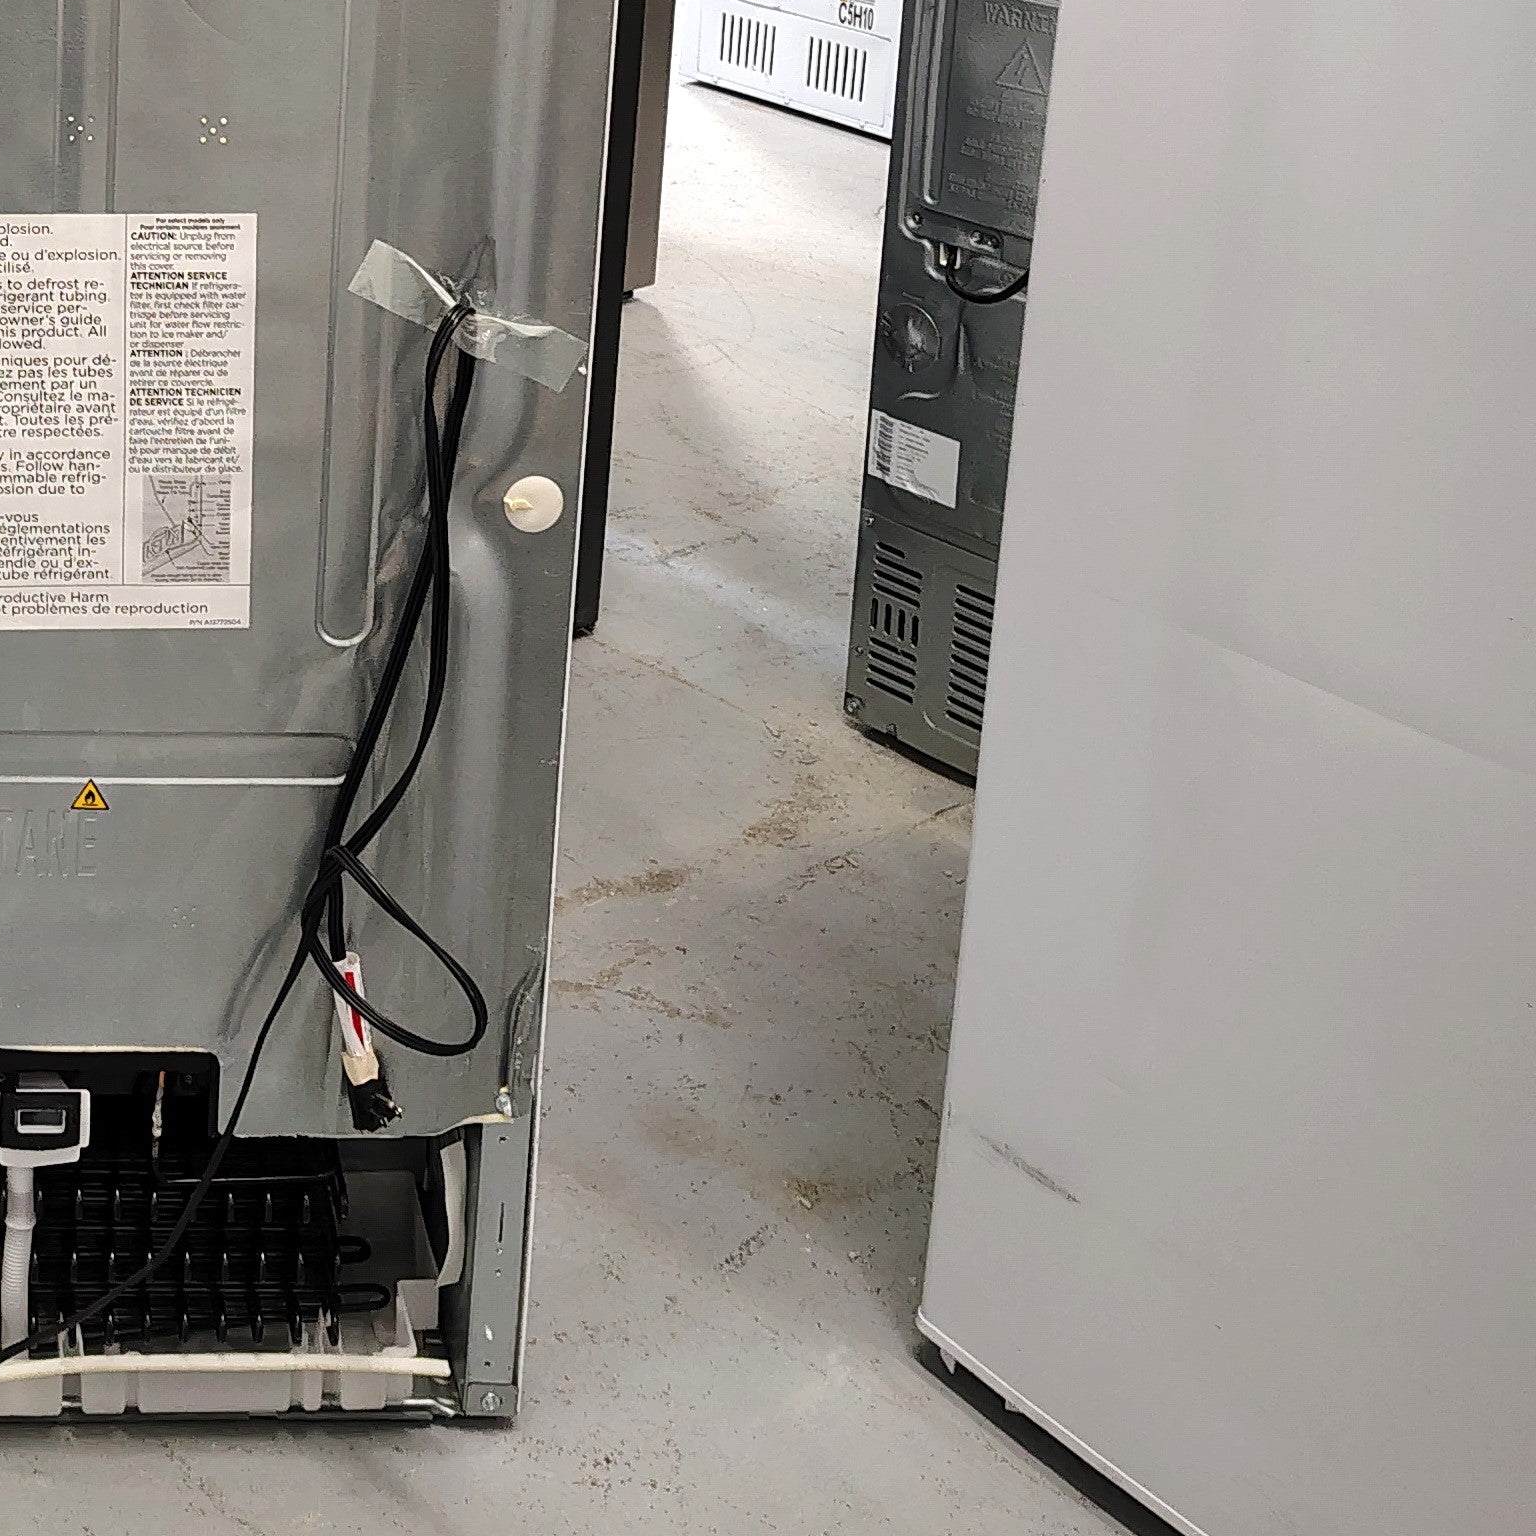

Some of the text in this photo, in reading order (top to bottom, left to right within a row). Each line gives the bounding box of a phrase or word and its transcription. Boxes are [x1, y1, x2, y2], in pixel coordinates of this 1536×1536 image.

[838, 2, 874, 30] C5H10
[11, 252, 29, 261] ou
[34, 249, 121, 263] d'explosion.
[130, 271, 227, 280] ATTENTION SERVICE
[7, 279, 22, 290] to
[26, 278, 79, 290] defrost
[84, 281, 104, 290] re-
[130, 281, 189, 290] TECHNICIAN
[0, 302, 52, 314] service
[57, 305, 87, 316] per-
[87, 326, 107, 338] All
[53, 357, 87, 369] pour
[17, 370, 43, 381] pas
[47, 367, 67, 378] les
[72, 367, 113, 378] tubes
[129, 387, 241, 396] ATTENTION TECHNICIEN
[75, 402, 115, 413] avant
[129, 397, 184, 406] DE SERVICE
[9, 449, 21, 461] in
[26, 449, 110, 460] accordance
[15, 460, 64, 472] Follow
[68, 460, 100, 471] han-
[40, 559, 59, 568] ou
[70, 591, 109, 603] Harm
[91, 603, 110, 615] de
[114, 603, 208, 617] reproduction
